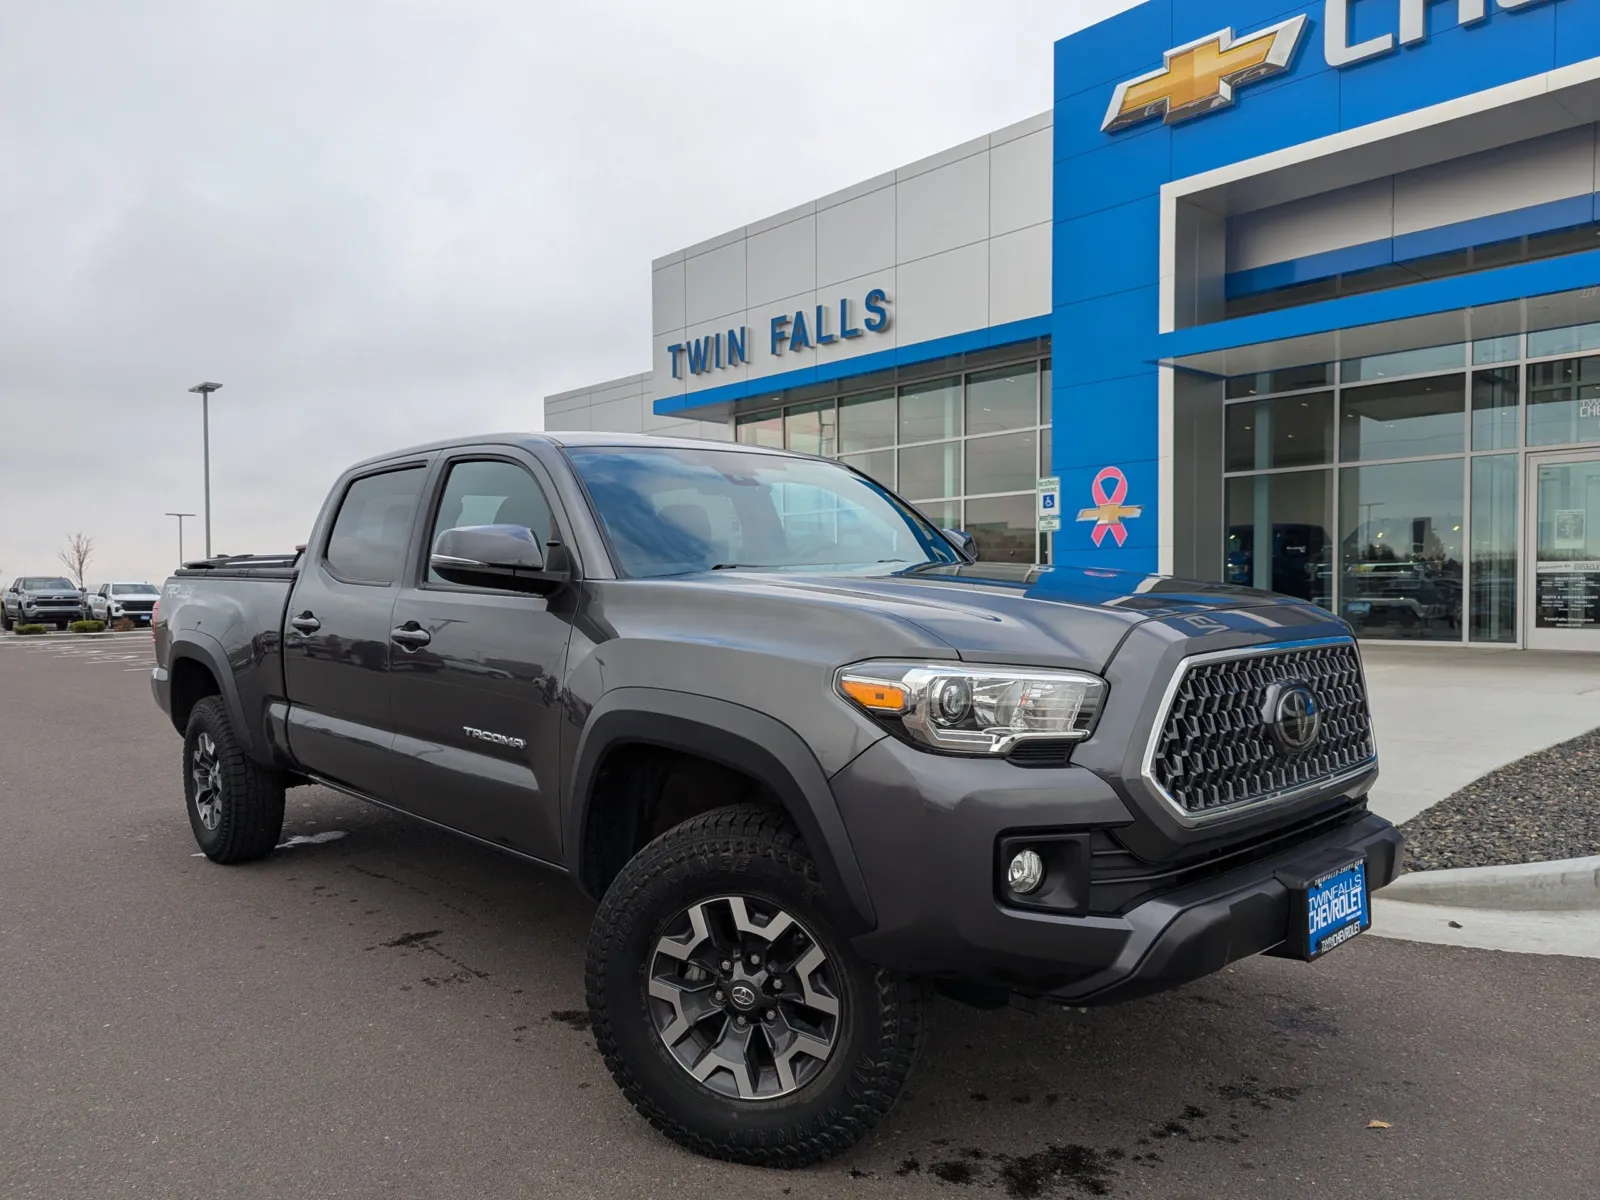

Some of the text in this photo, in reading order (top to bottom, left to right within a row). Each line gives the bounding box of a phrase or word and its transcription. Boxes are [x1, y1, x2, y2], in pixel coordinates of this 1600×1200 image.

[667, 288, 892, 379] TWIN FALLS
[463, 726, 527, 749] TACOMA
[1309, 887, 1362, 935] CHEVROLET
